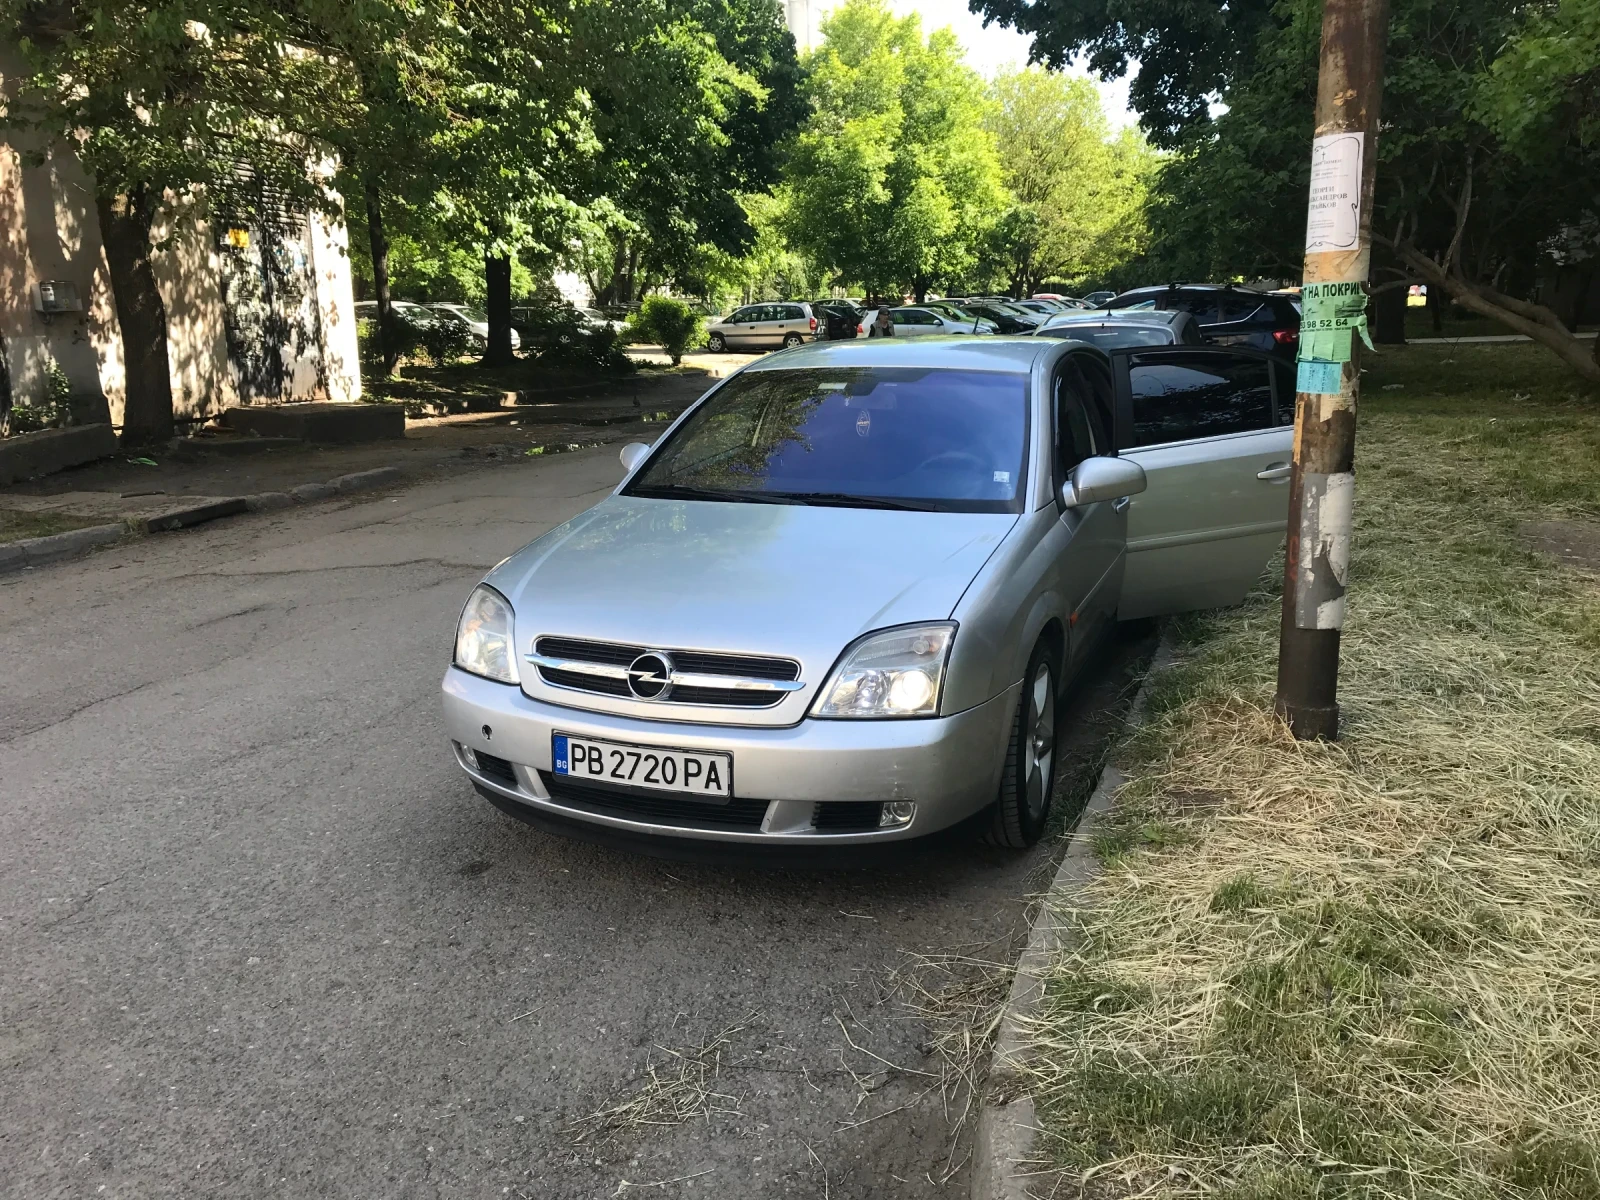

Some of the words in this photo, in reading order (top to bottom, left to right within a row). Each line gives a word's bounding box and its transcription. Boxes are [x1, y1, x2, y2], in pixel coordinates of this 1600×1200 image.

[1308, 286, 1320, 299] НА
[1307, 320, 1317, 329] 98
[1319, 319, 1332, 328] 52
[1335, 318, 1348, 327] 64
[556, 759, 568, 770] BG
[571, 743, 604, 775] PB
[609, 750, 677, 785] 2720
[684, 758, 722, 790] PA
